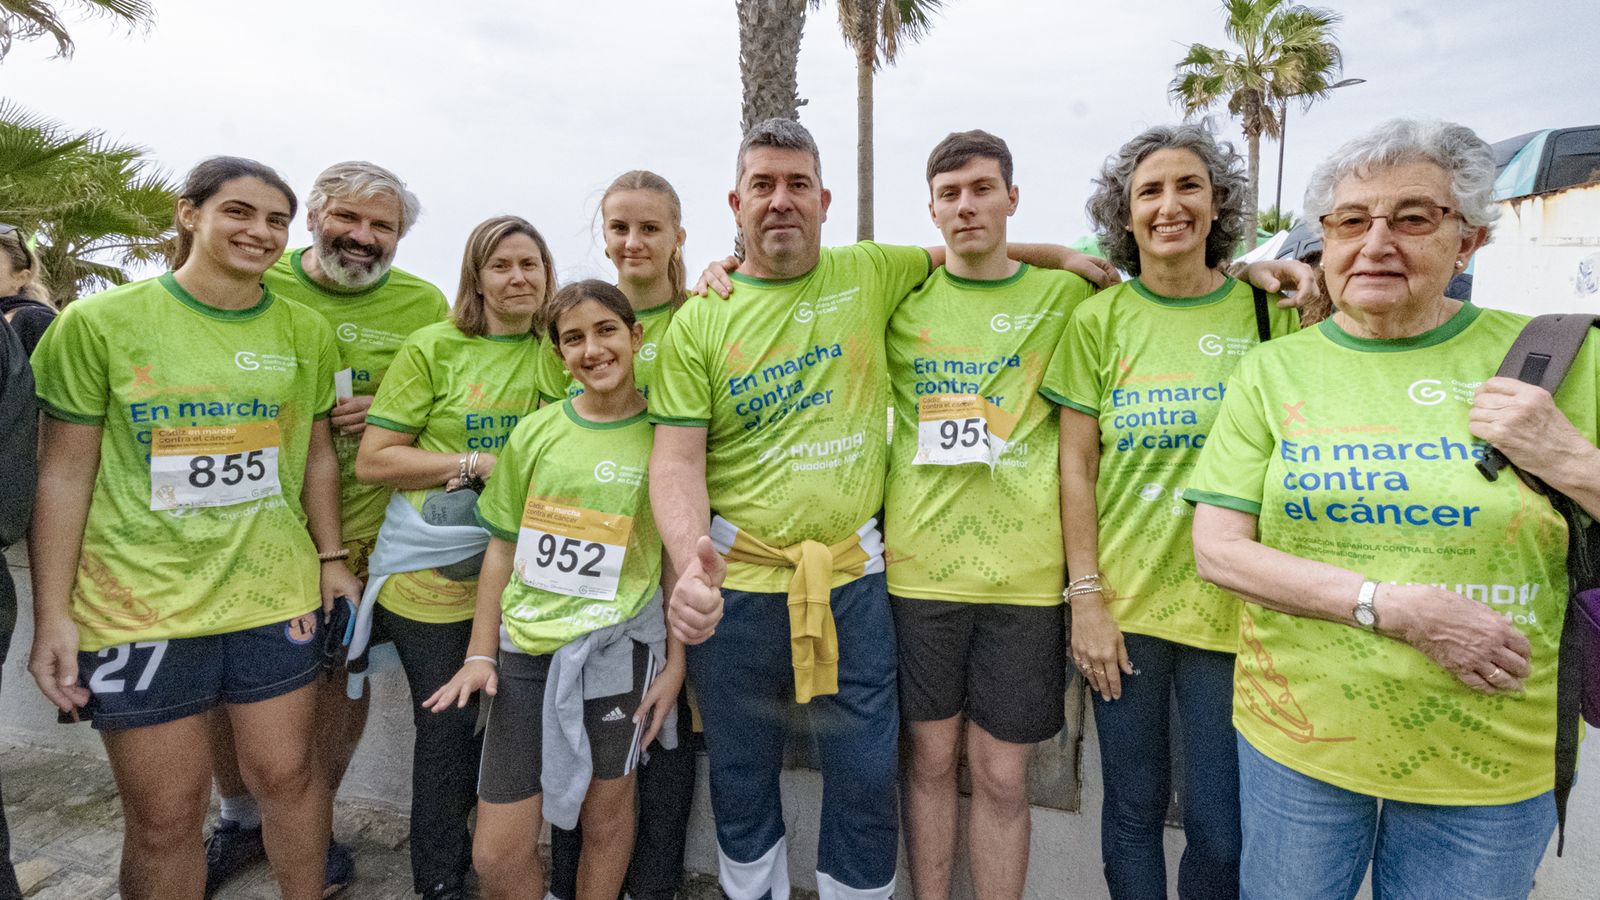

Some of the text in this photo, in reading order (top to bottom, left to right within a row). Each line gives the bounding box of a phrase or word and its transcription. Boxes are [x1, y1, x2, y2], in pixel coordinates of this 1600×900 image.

[729, 343, 843, 396] En marcha
[914, 357, 937, 375] En
[735, 379, 804, 416] contra
[915, 378, 980, 395] contra
[1112, 383, 1226, 408] En march
[130, 398, 281, 423] En marcha
[466, 414, 494, 430] En
[744, 414, 762, 430] el
[1114, 407, 1198, 429] contra
[158, 435, 190, 443] contra
[204, 433, 236, 441] cáncer
[202, 427, 237, 435] marcha
[791, 430, 866, 457] HYUNDA
[1117, 430, 1206, 452] el cánc
[1281, 437, 1488, 463] En marcha
[189, 450, 265, 488] 855
[1283, 466, 1409, 491] contra
[1284, 496, 1480, 527] el cáncer
[536, 534, 606, 578] 952
[1382, 545, 1420, 553] CONTRA
[1423, 546, 1434, 554] EL
[1436, 546, 1477, 555] CÁNCER
[89, 639, 169, 694] 27
